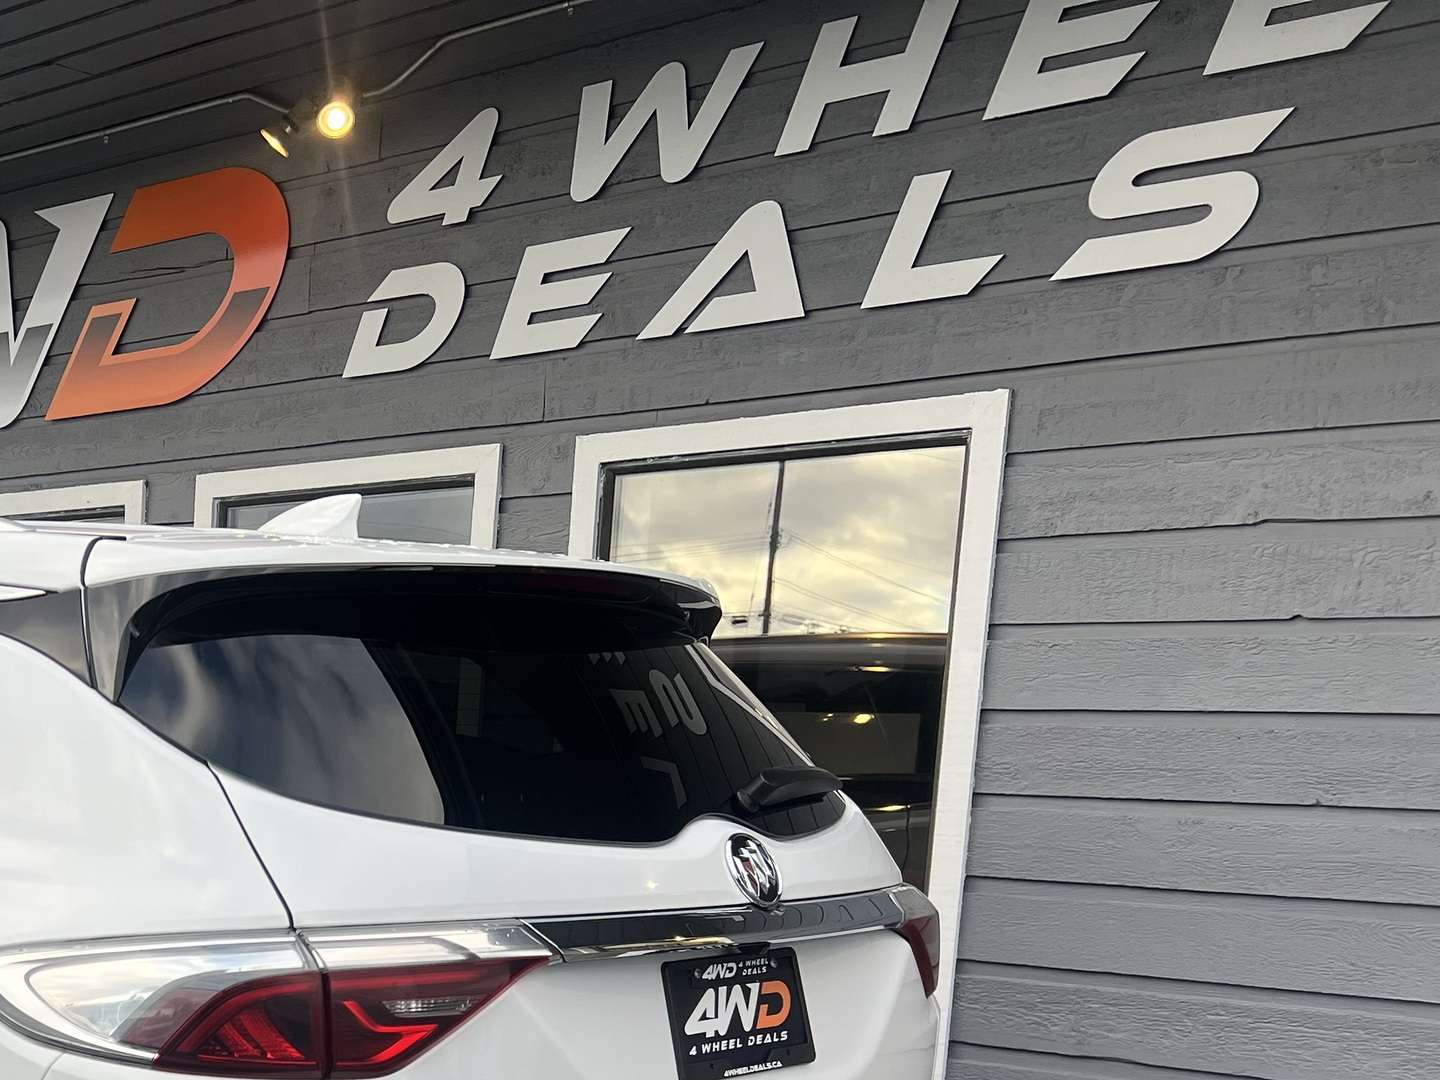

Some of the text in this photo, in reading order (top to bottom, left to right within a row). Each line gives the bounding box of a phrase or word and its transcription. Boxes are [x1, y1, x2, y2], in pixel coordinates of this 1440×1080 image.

[385, 107, 506, 227] 4
[341, 107, 1295, 379] DEALS
[701, 962, 737, 980] 4WD
[742, 966, 767, 976] DEALS
[745, 957, 769, 967] WHEEL
[684, 980, 792, 1038] 4WD
[689, 1030, 789, 1056] 4 WHEEL DEALS
